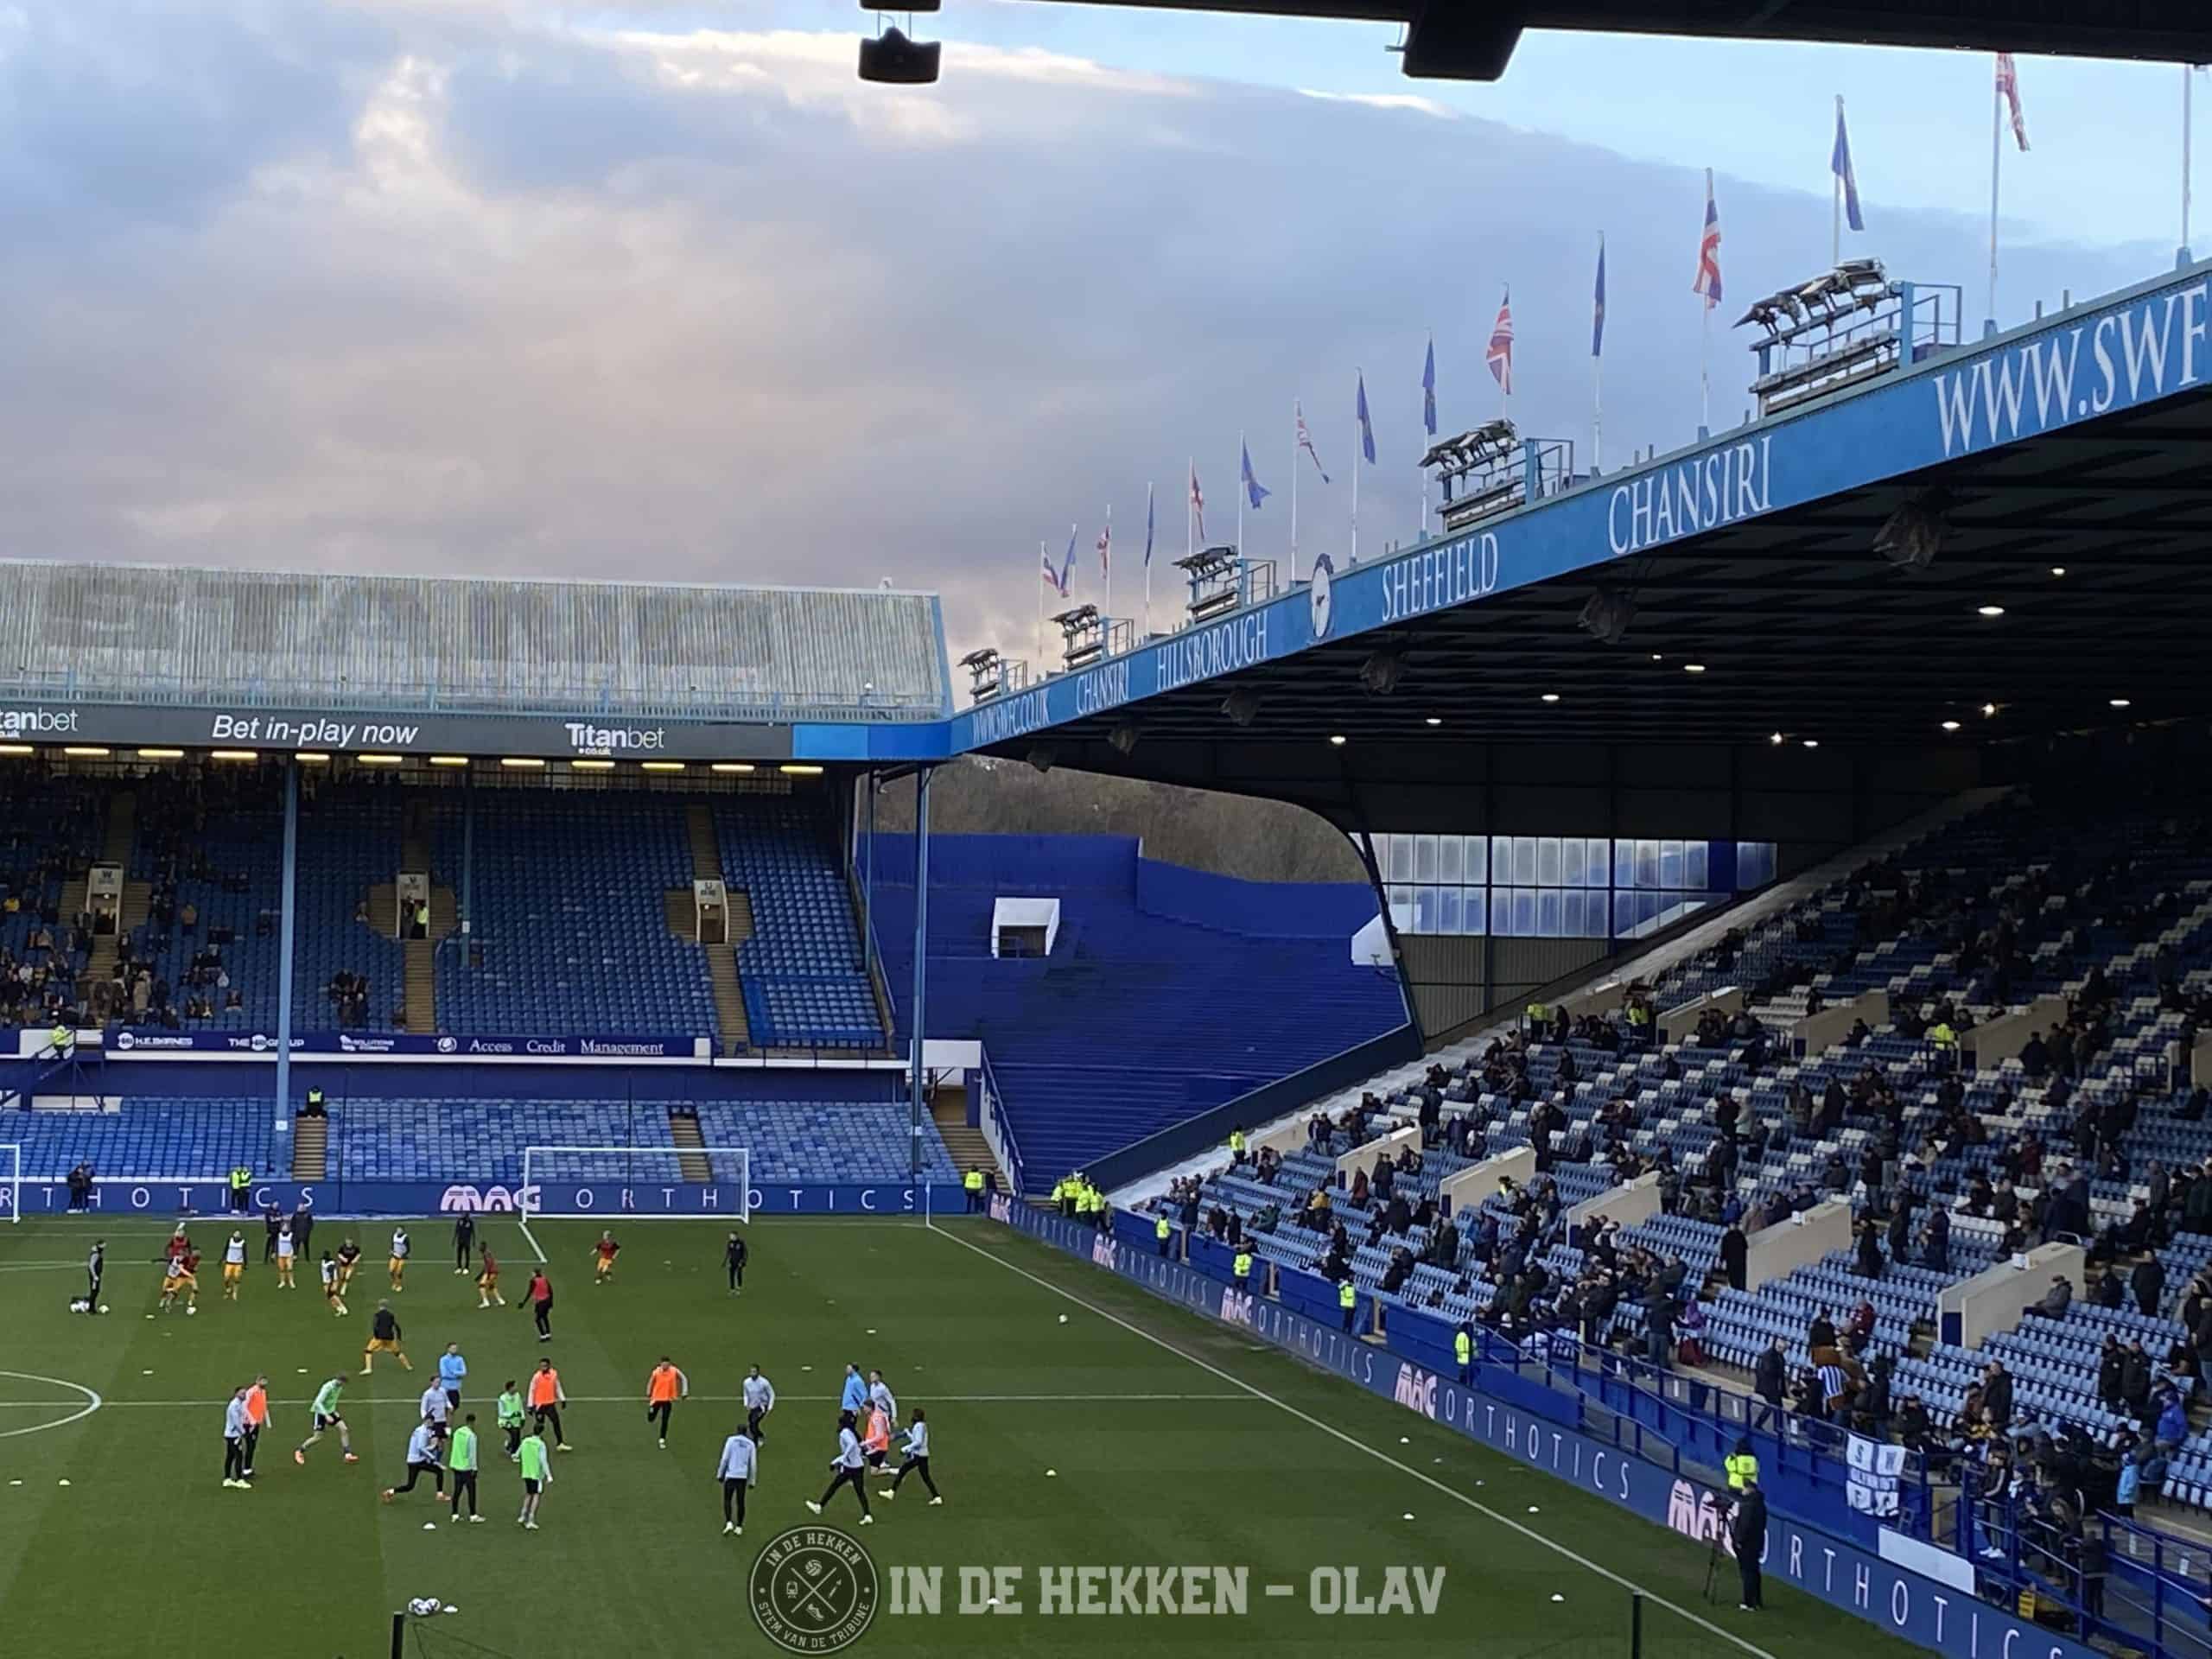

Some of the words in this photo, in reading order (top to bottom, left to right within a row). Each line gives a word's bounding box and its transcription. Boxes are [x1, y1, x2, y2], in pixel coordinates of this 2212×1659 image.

[1934, 284, 2209, 457] WWW.SWF
[1607, 435, 1774, 556] CHANSIRI
[1382, 531, 1498, 622] SHEFFIELD
[1156, 609, 1269, 692] HILLSBOROUGH
[0, 706, 79, 732] anbet
[1076, 658, 1130, 715] CHANSIRI
[213, 715, 260, 739] Bet
[265, 716, 356, 747] in-play
[361, 724, 419, 744] now
[564, 722, 665, 749] Titanbet
[469, 1039, 512, 1052] Access
[526, 1039, 566, 1053] Credit
[581, 1039, 664, 1055] Management
[575, 1188, 914, 1210] ORTHOTICS
[1257, 1305, 1374, 1383] ORTHOTICS
[1445, 1388, 1630, 1500] ORTHOTICS
